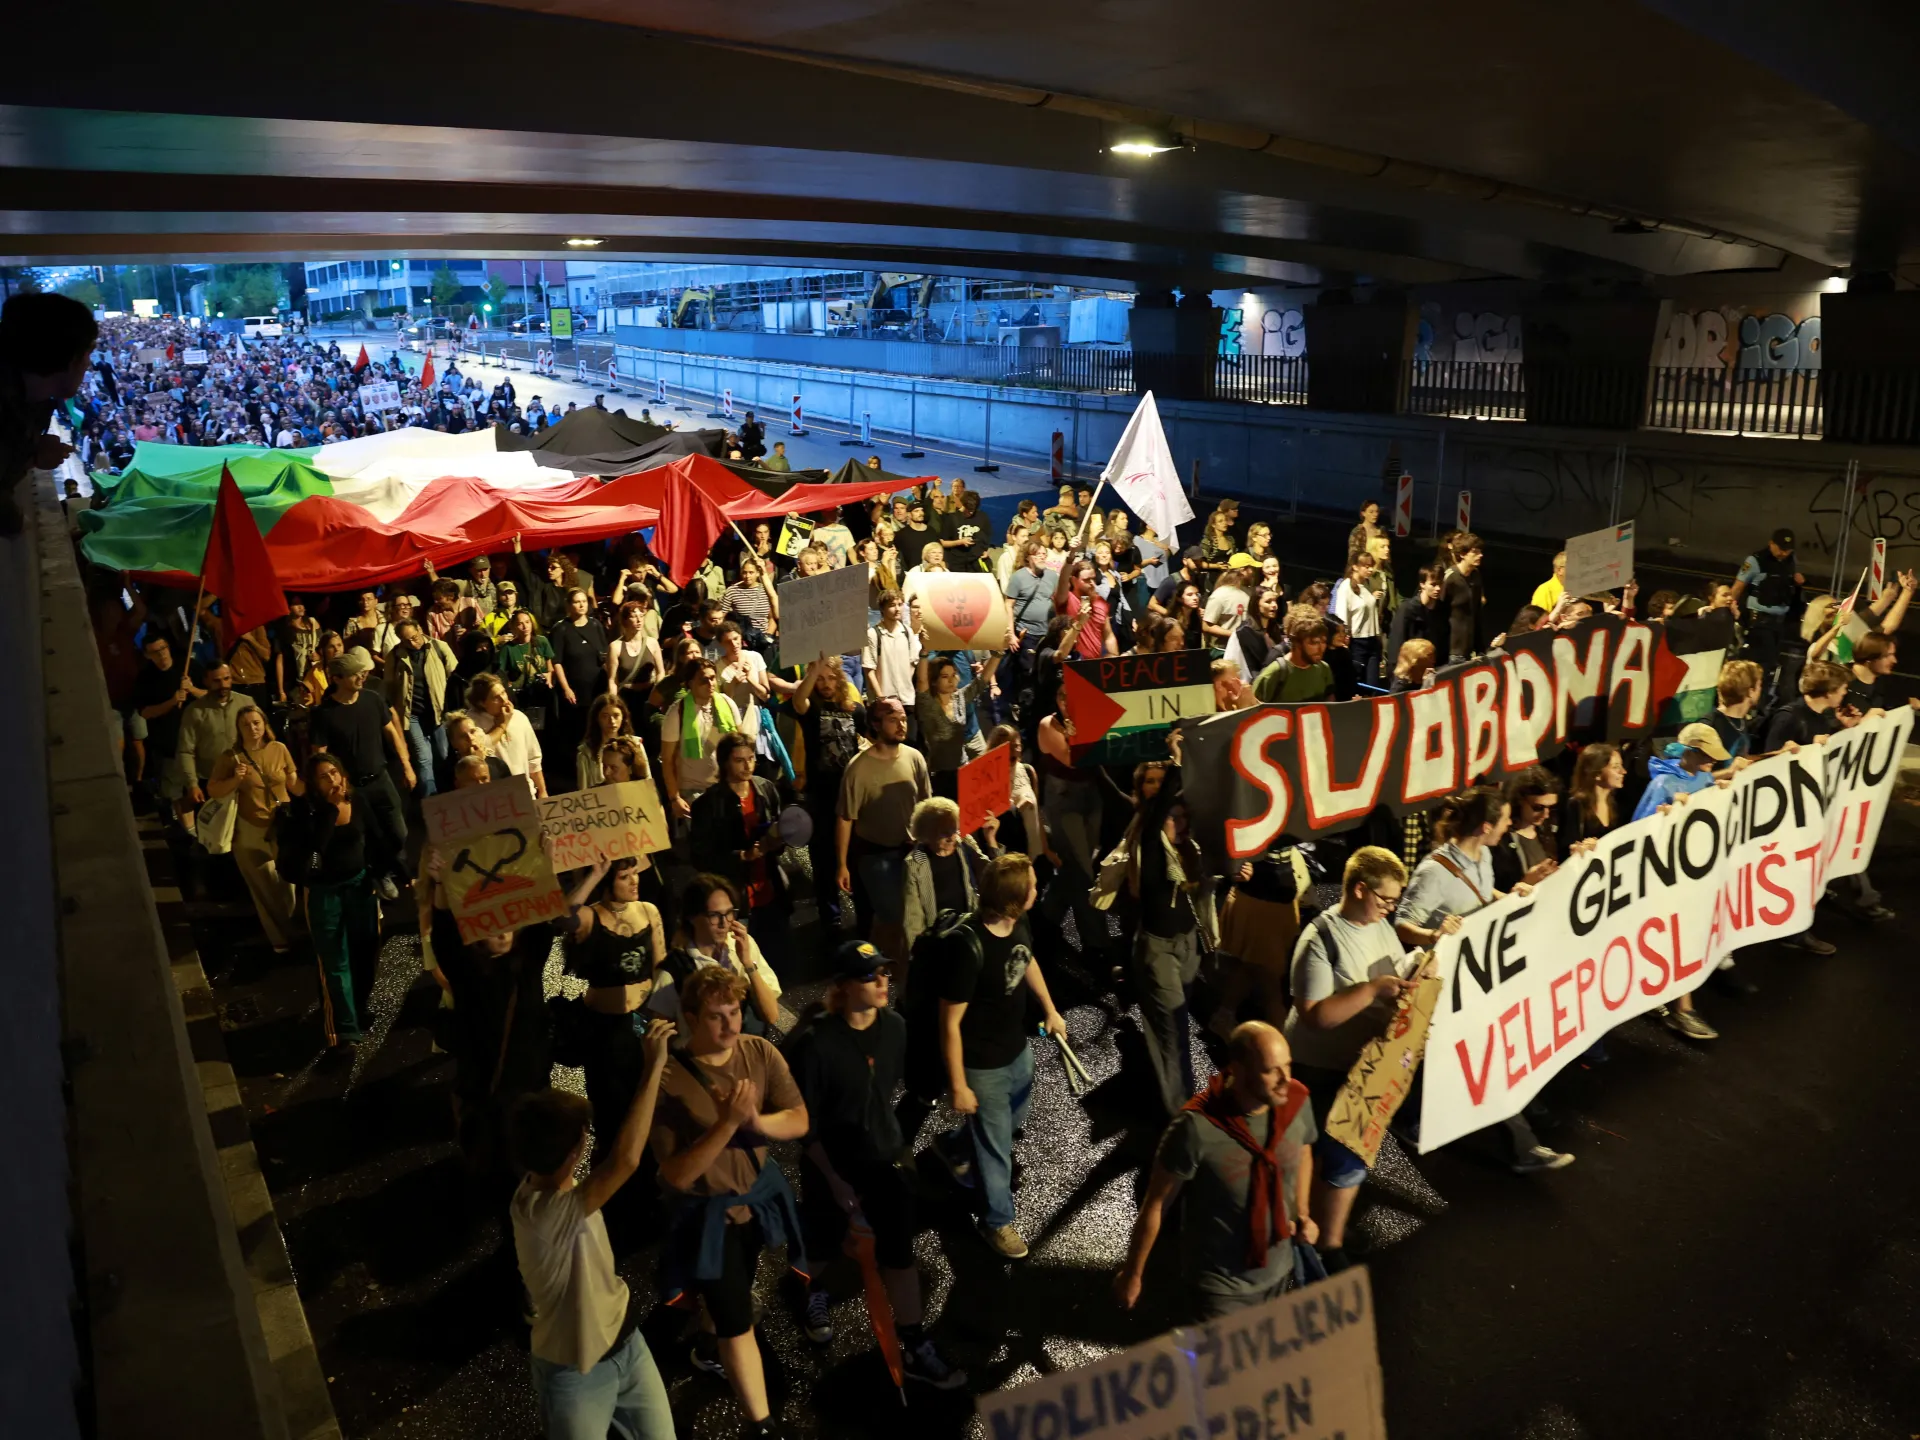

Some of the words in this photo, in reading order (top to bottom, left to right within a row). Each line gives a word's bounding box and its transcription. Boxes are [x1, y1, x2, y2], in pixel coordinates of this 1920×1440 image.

[1100, 654, 1189, 689] PEACE
[1147, 693, 1182, 720] IN
[537, 792, 607, 821] IZRAEL
[1452, 902, 1537, 1014] NE
[988, 1352, 1179, 1440] KOLIKO
